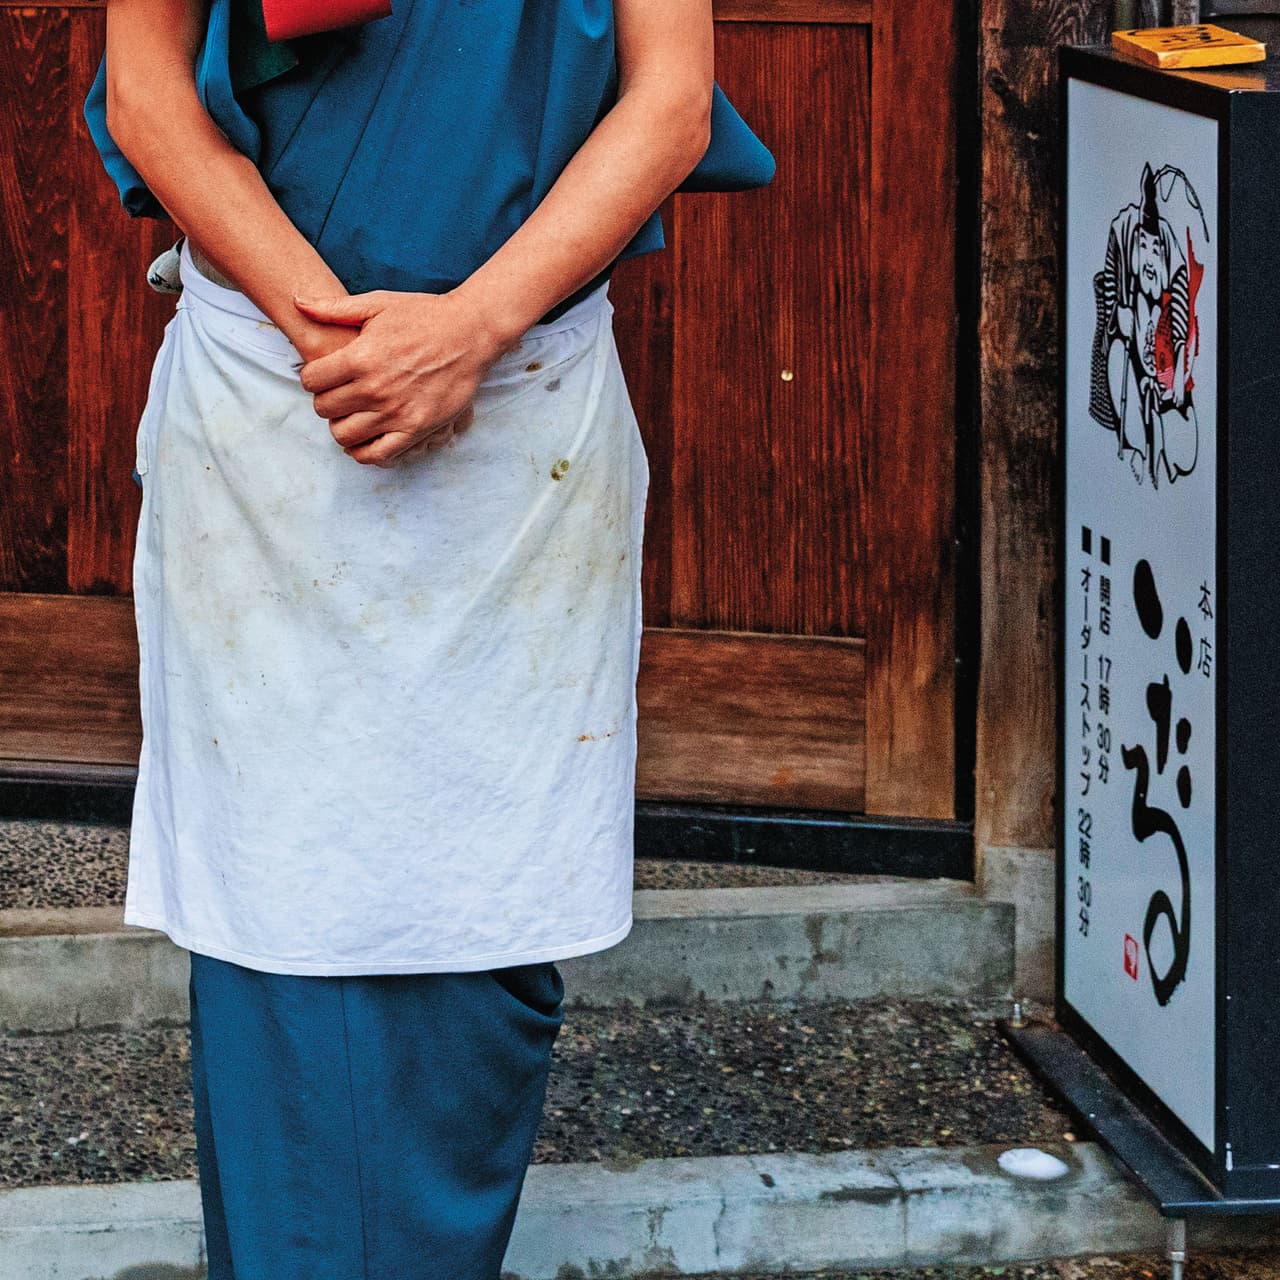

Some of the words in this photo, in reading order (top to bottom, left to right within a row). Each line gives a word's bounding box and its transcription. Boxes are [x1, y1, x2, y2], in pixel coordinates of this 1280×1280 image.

[1197, 580, 1214, 678] 本店
[1120, 558, 1193, 1007] いたる
